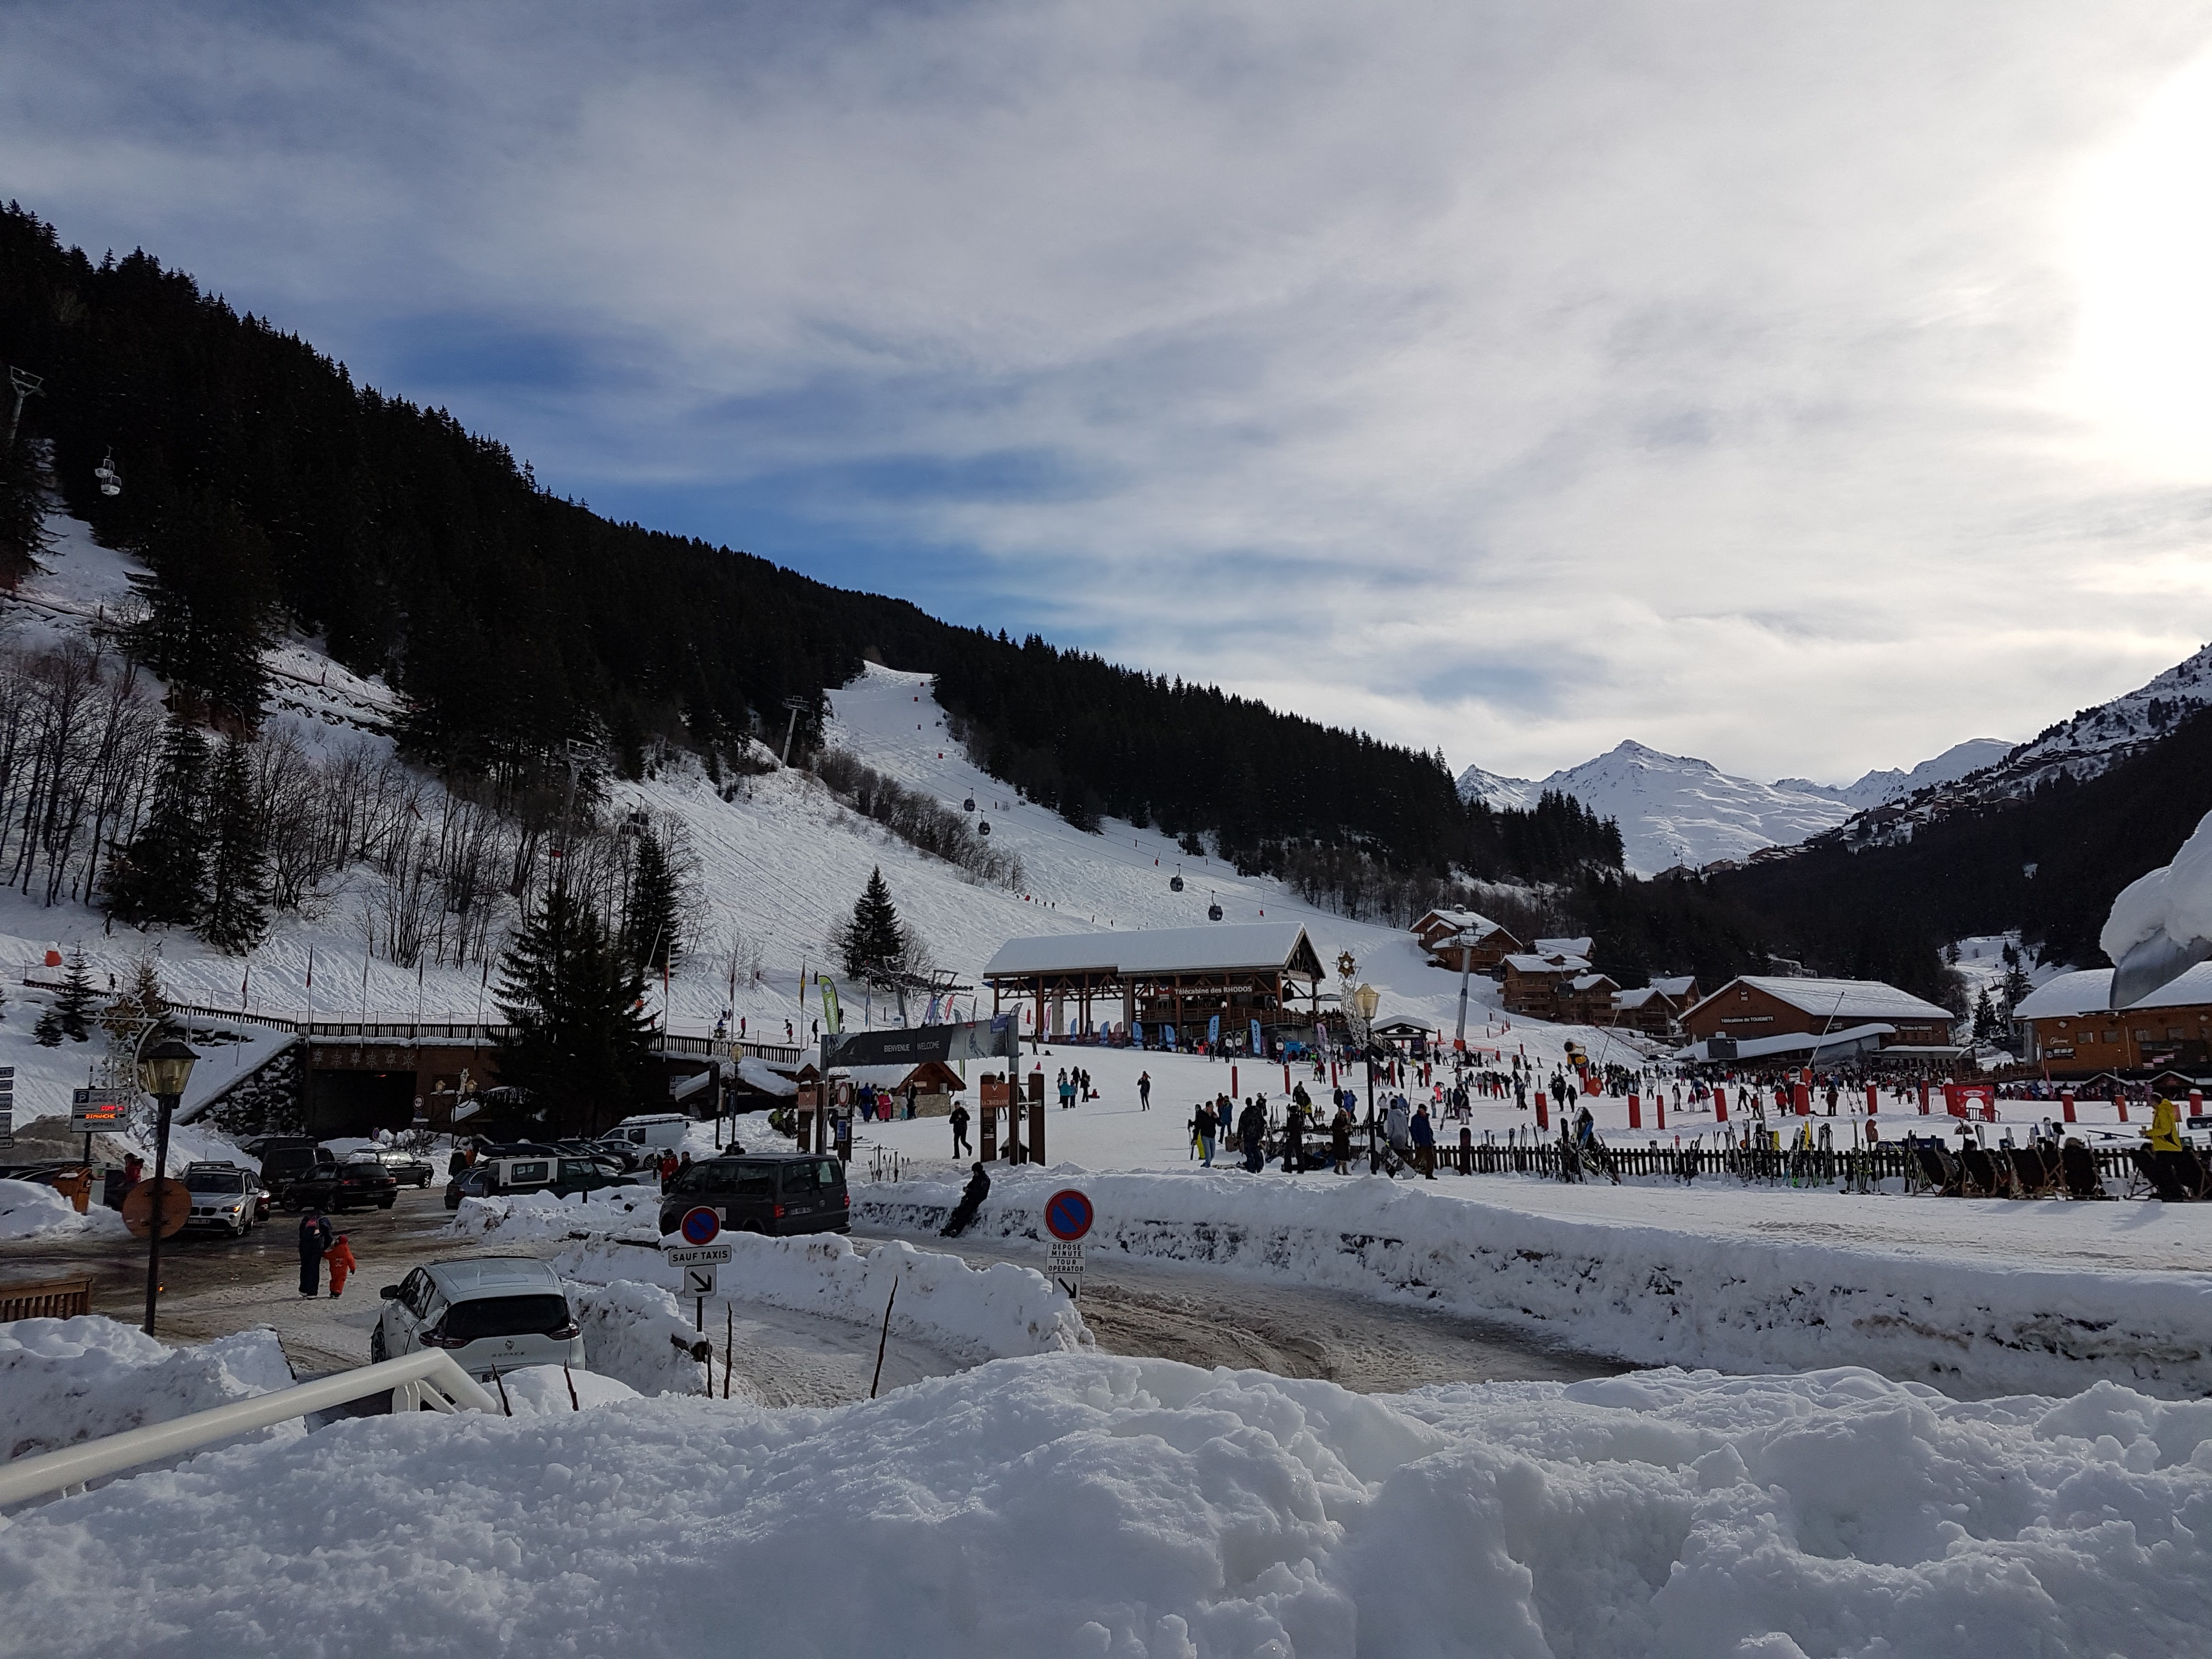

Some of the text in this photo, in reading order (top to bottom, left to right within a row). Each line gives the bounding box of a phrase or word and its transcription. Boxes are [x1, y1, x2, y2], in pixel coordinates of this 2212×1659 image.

[884, 1041, 940, 1053] BIENVENUE WELCOME
[673, 1250, 728, 1262] SAUF TAXIS
